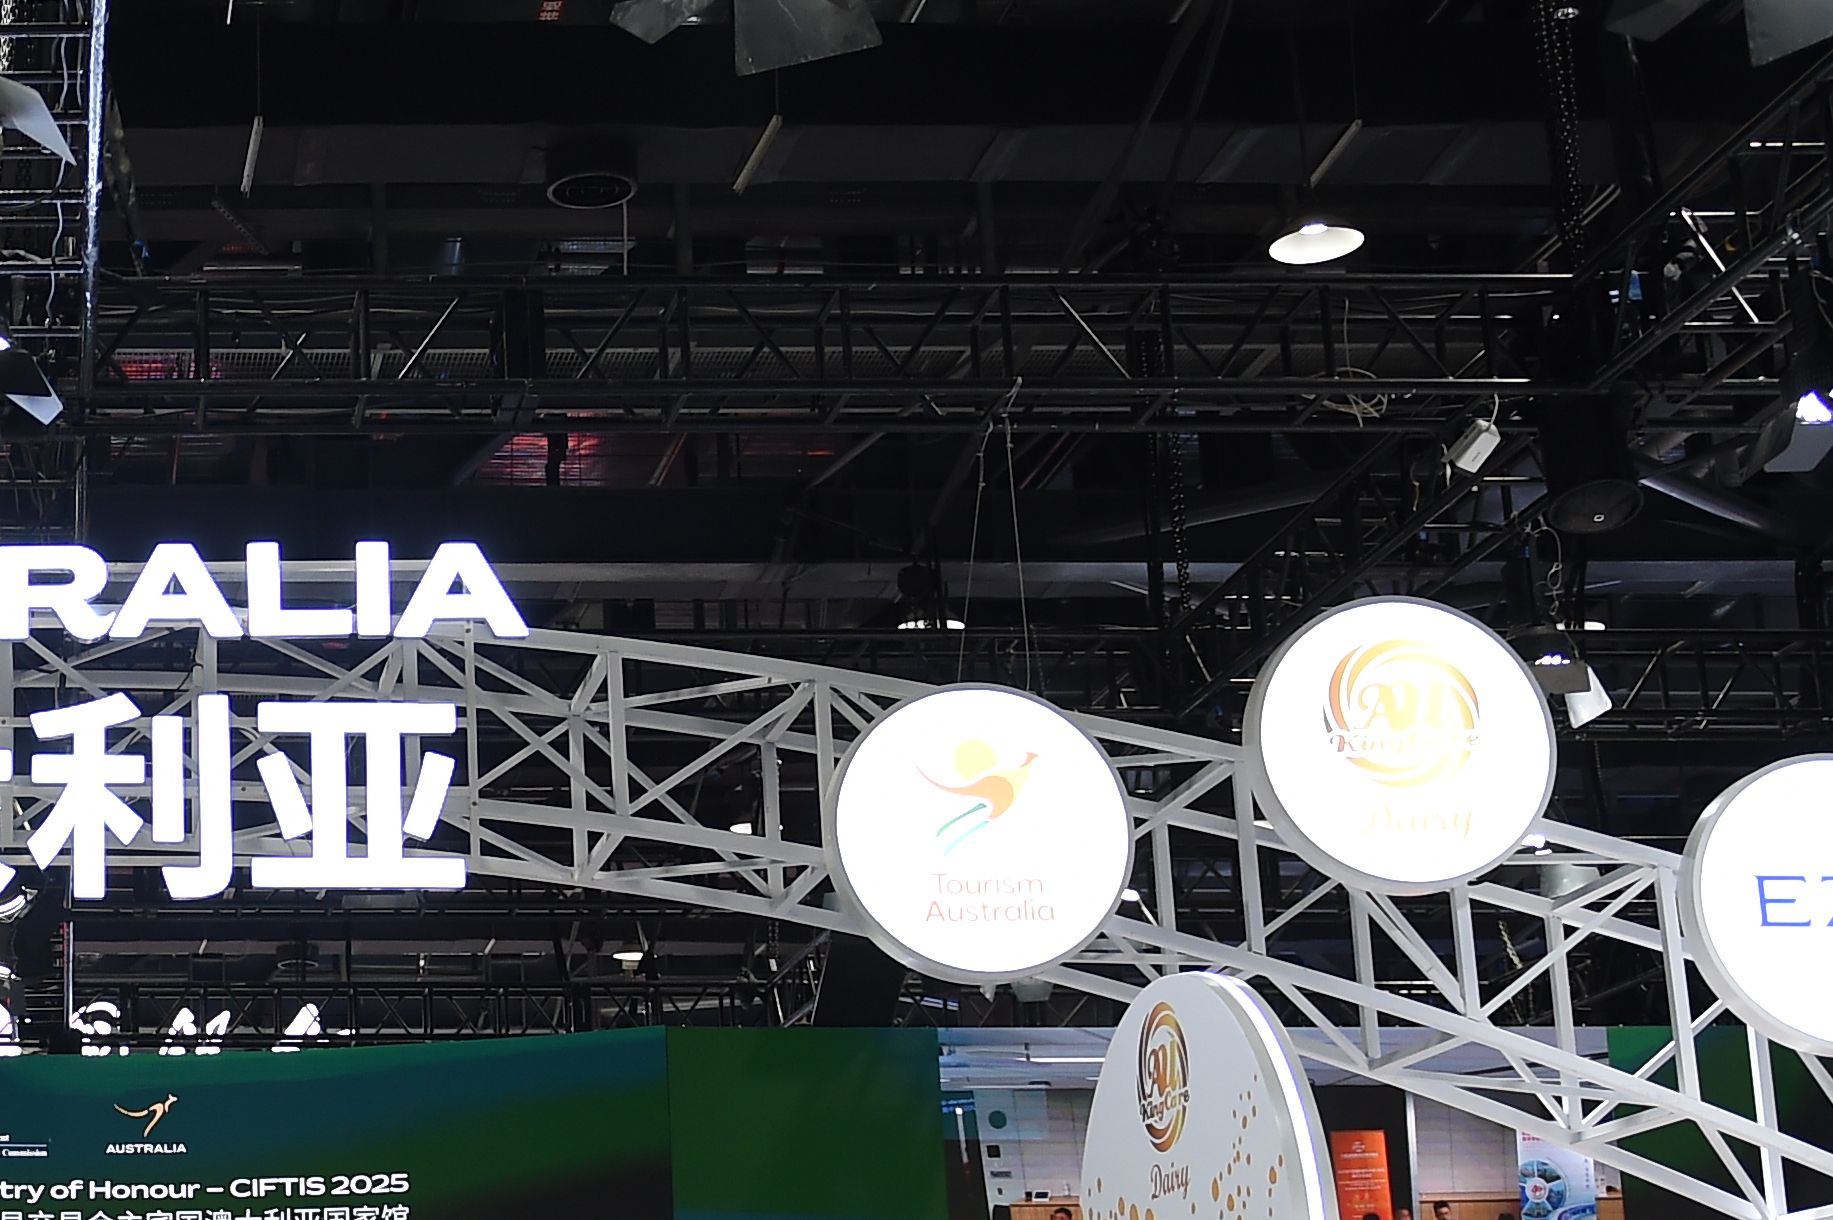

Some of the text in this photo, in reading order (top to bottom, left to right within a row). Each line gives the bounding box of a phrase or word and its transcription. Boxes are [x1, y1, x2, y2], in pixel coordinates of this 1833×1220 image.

[932, 872, 1043, 894] Tourism
[926, 898, 1055, 922] Australia
[1139, 1089, 1190, 1123] KingCare
[105, 1143, 187, 1154] AUSTRALIA
[50, 1179, 84, 1200] of
[89, 1180, 201, 1200] Honour
[230, 1176, 326, 1198] CIFTIS
[330, 1173, 410, 1195] 2025
[1151, 1161, 1191, 1200] Dairy
